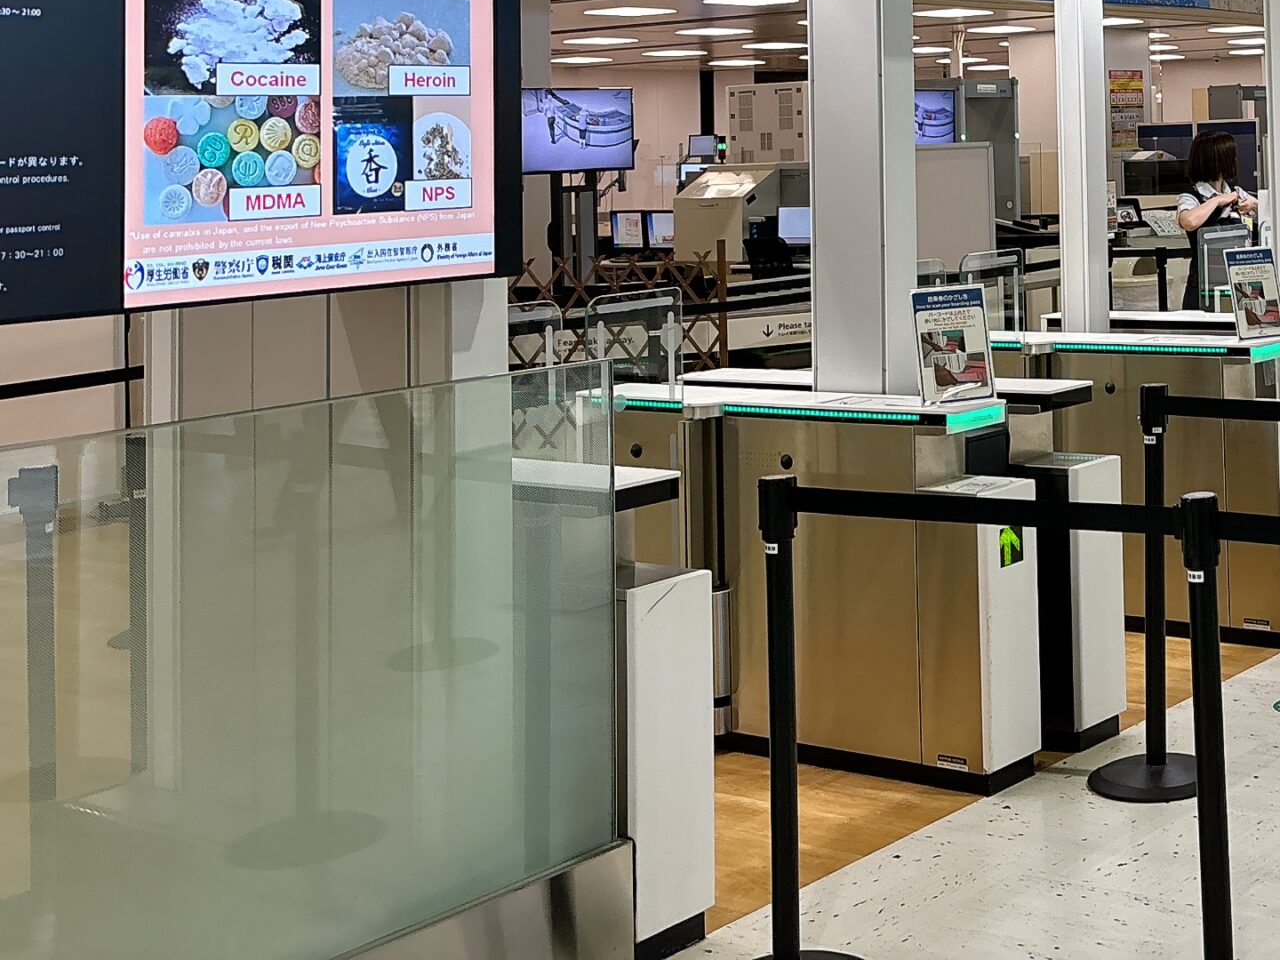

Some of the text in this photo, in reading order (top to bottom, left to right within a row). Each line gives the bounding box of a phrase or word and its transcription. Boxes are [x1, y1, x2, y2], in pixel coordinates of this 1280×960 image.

[230, 71, 307, 89] Cocaine
[403, 72, 456, 88] Heroin
[0, 174, 70, 185] ntrol procedures.
[422, 185, 456, 202] NPS
[245, 194, 306, 211] MDMA
[214, 258, 255, 275] 警察庁
[272, 254, 294, 270] 税関
[146, 266, 189, 283] 厚生労働省
[778, 323, 803, 334] Please
